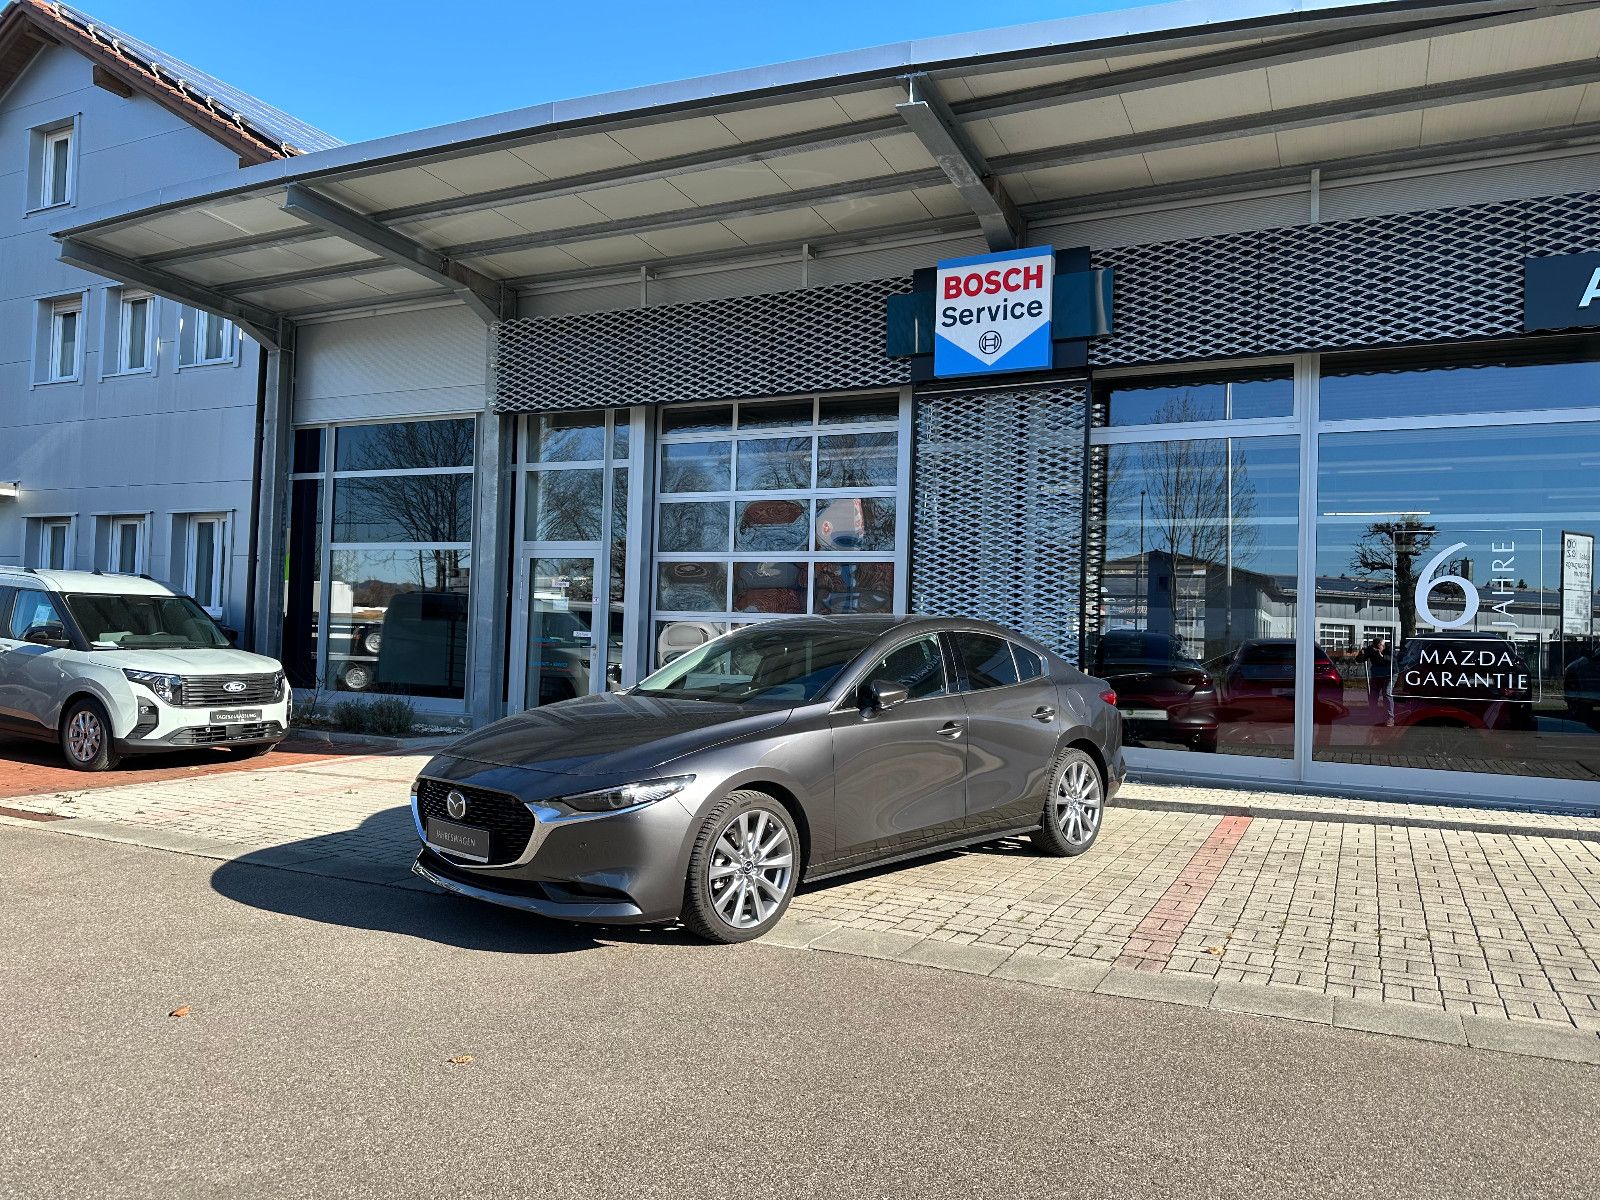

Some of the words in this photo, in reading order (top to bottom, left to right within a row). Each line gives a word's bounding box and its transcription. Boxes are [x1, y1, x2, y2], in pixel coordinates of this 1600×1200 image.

[944, 265, 1044, 300] BOSCH
[941, 297, 1043, 328] Service
[1414, 541, 1480, 628] 6
[1491, 541, 1519, 628] JAHRE
[1419, 649, 1514, 667] MAZDA
[1405, 670, 1528, 690] GARANTIE
